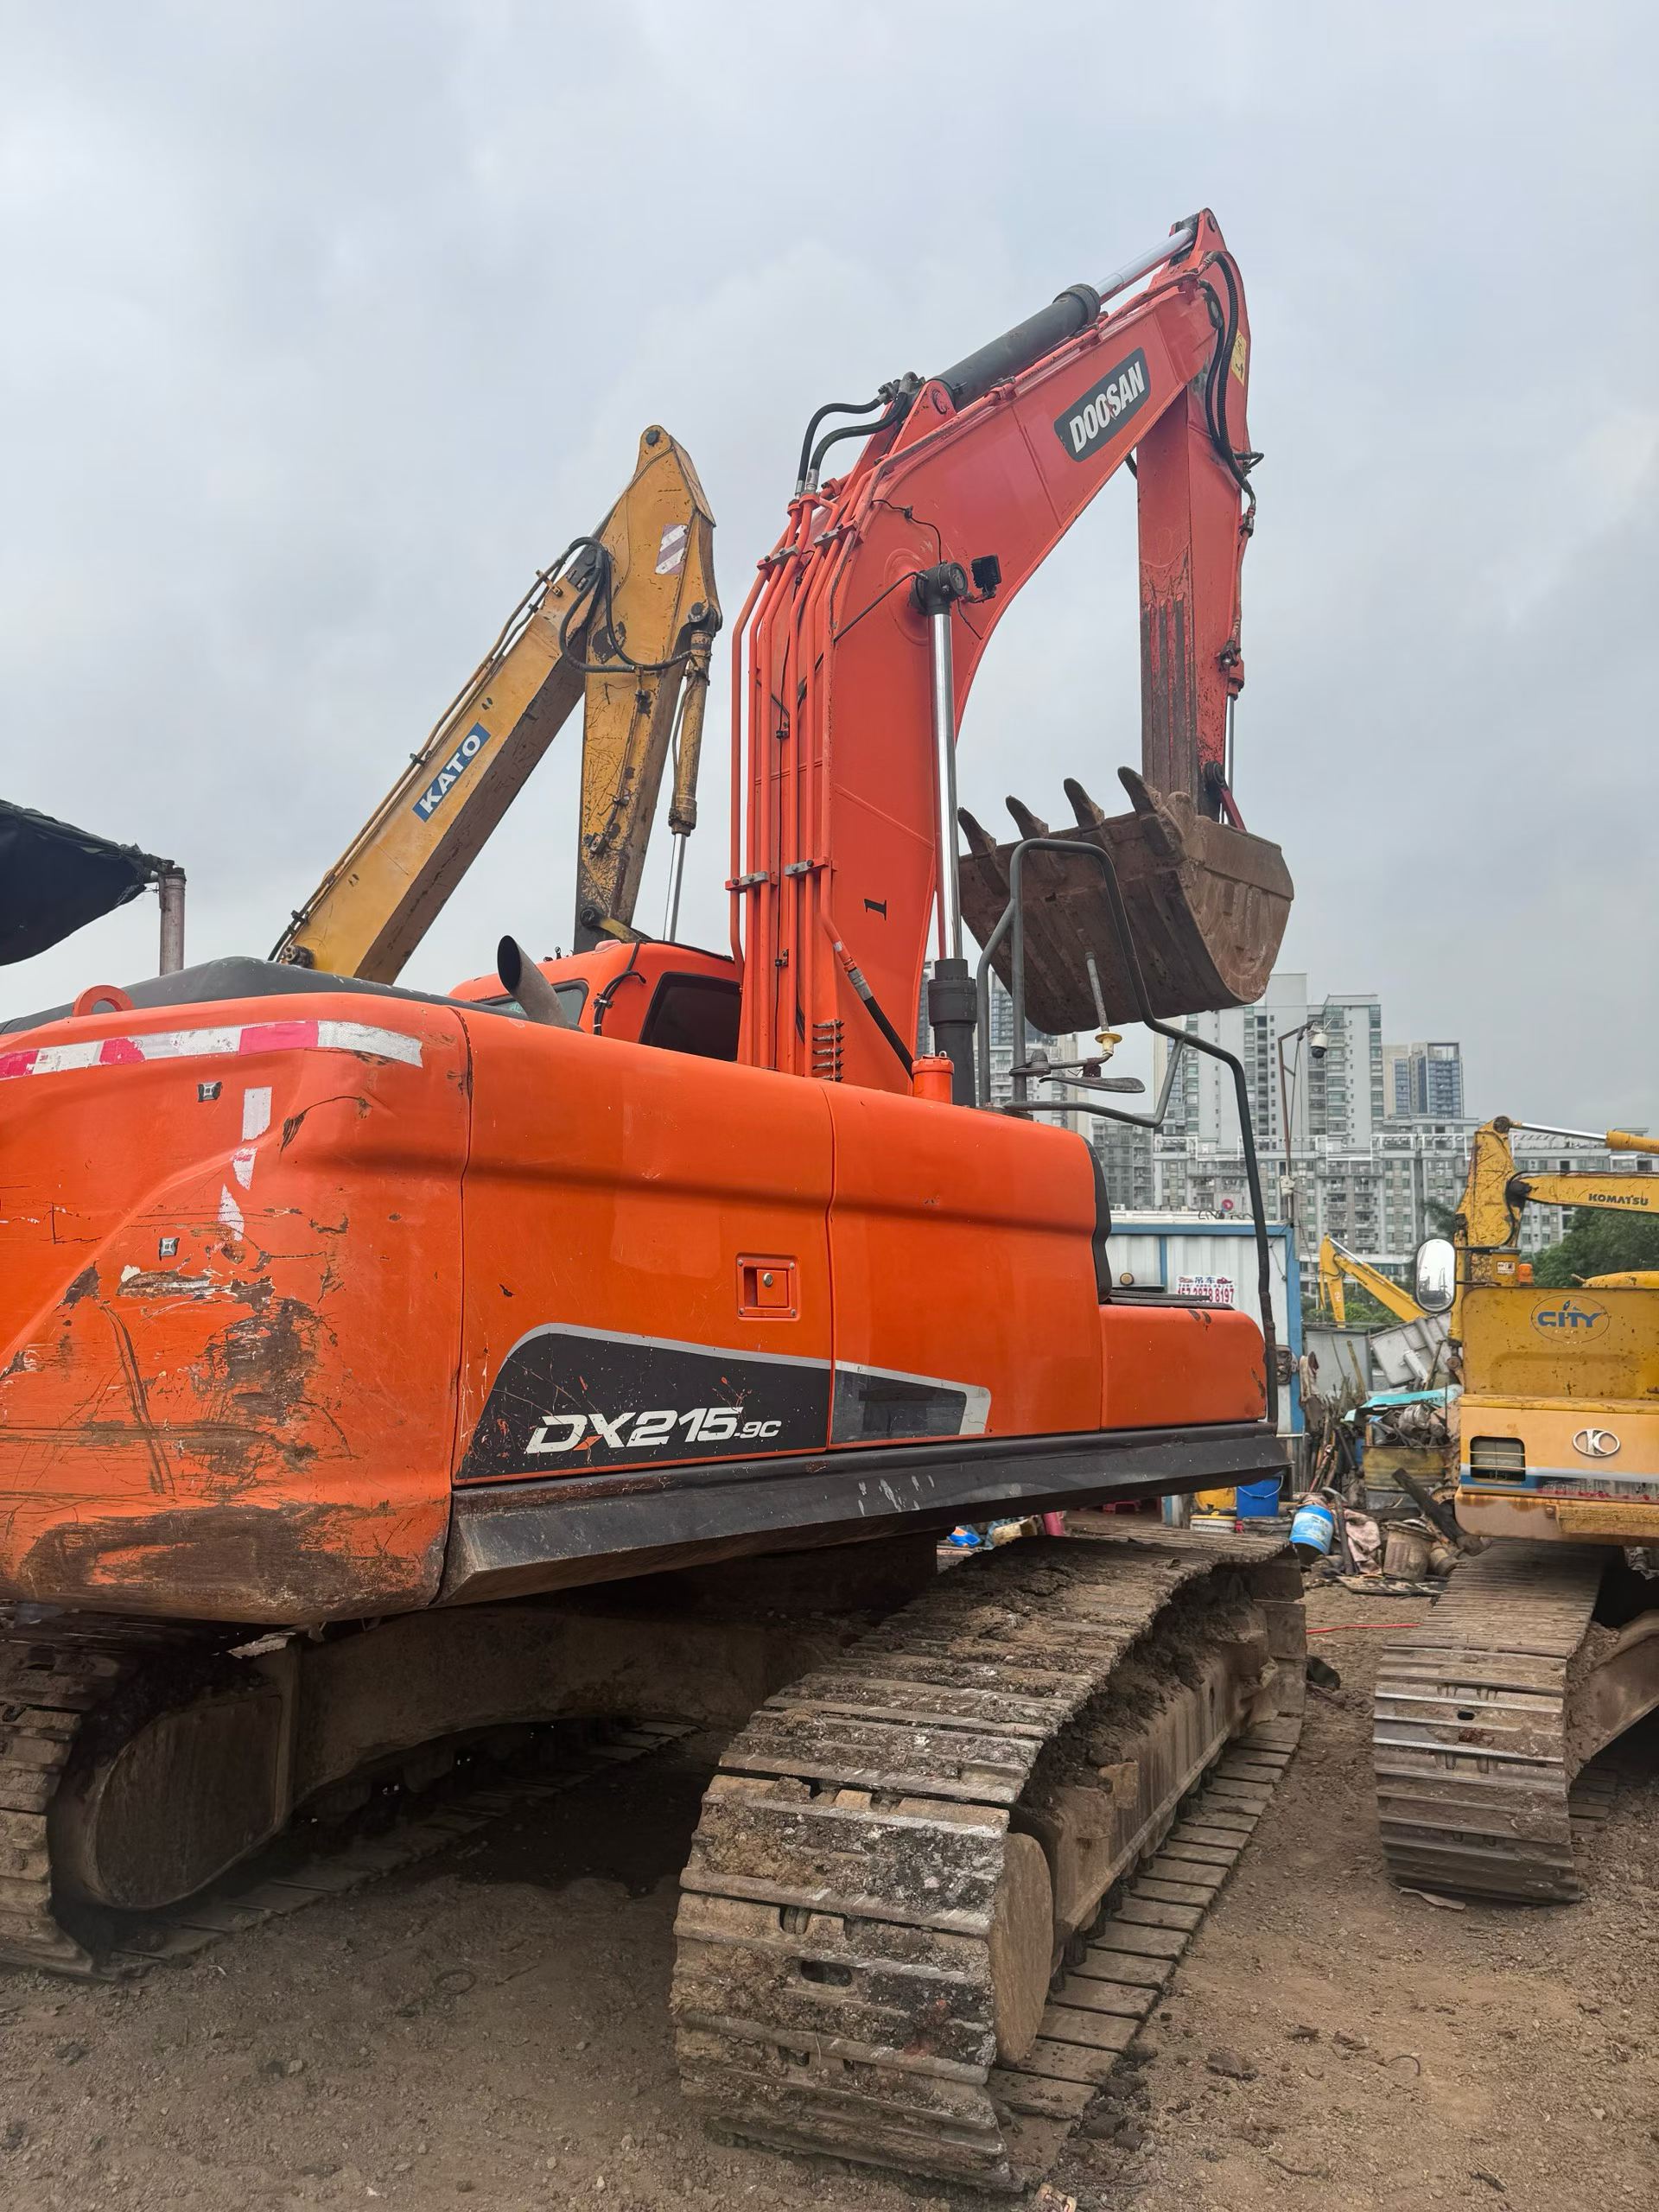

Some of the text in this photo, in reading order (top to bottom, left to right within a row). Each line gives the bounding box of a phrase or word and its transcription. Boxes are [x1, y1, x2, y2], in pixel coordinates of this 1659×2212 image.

[1069, 360, 1145, 454] DOOSAN
[419, 734, 481, 813] KATO
[1588, 1193, 1649, 1206] KOMATSU
[1537, 1310, 1605, 1328] CITY
